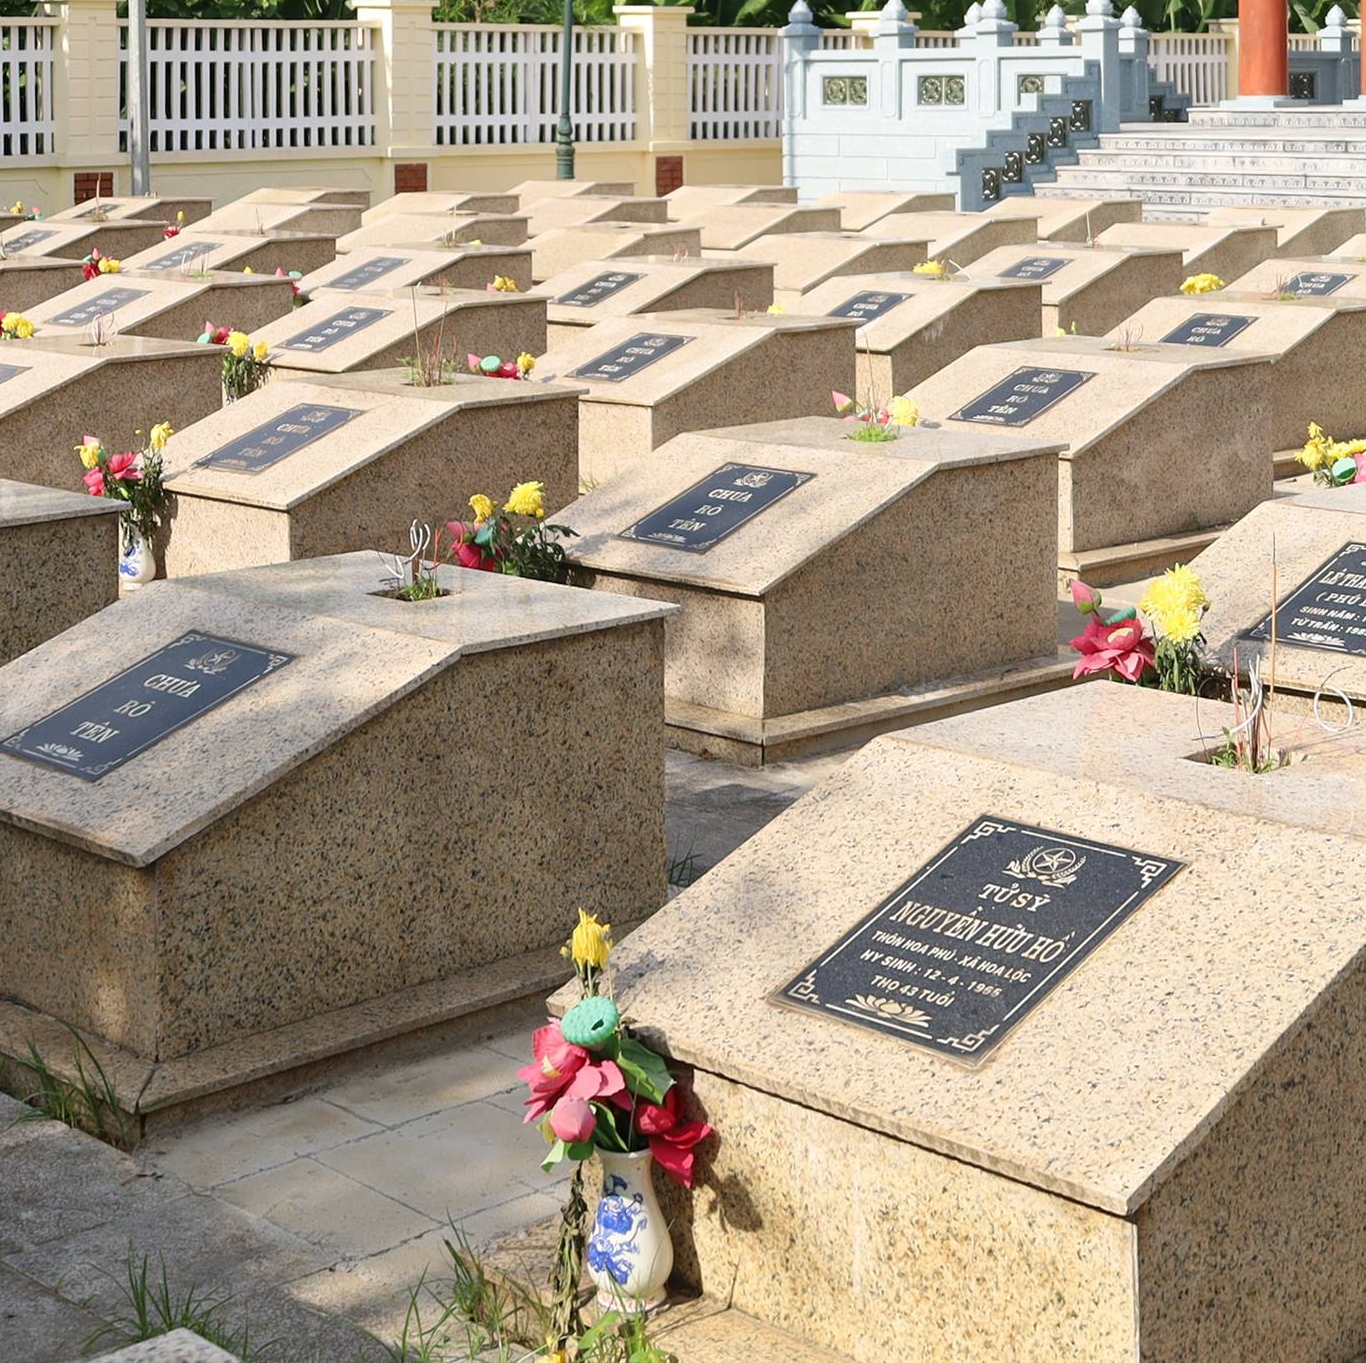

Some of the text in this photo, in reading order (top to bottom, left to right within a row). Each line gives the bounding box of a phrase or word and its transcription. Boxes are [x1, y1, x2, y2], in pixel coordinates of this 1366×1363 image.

[708, 488, 752, 502] CHƯA
[668, 518, 706, 532] TÊN
[1318, 568, 1347, 585] LÊ
[1300, 606, 1329, 616] SINH
[1327, 609, 1356, 620] NĂM
[144, 674, 200, 698] CHƯA
[71, 721, 119, 743] TÊN
[978, 883, 1020, 903] TỬ
[890, 901, 988, 940] NGUYỄN
[860, 949, 884, 962] HY
[881, 956, 917, 973] SINH
[872, 930, 906, 947] THÔN
[901, 939, 930, 954] HOA
[927, 947, 957, 961] PHÚ
[957, 955, 981, 969] XÃ
[976, 960, 1006, 976] HOA
[1003, 968, 1032, 983] LỘC
[871, 975, 955, 1007] THỌ 43 TUỔI
